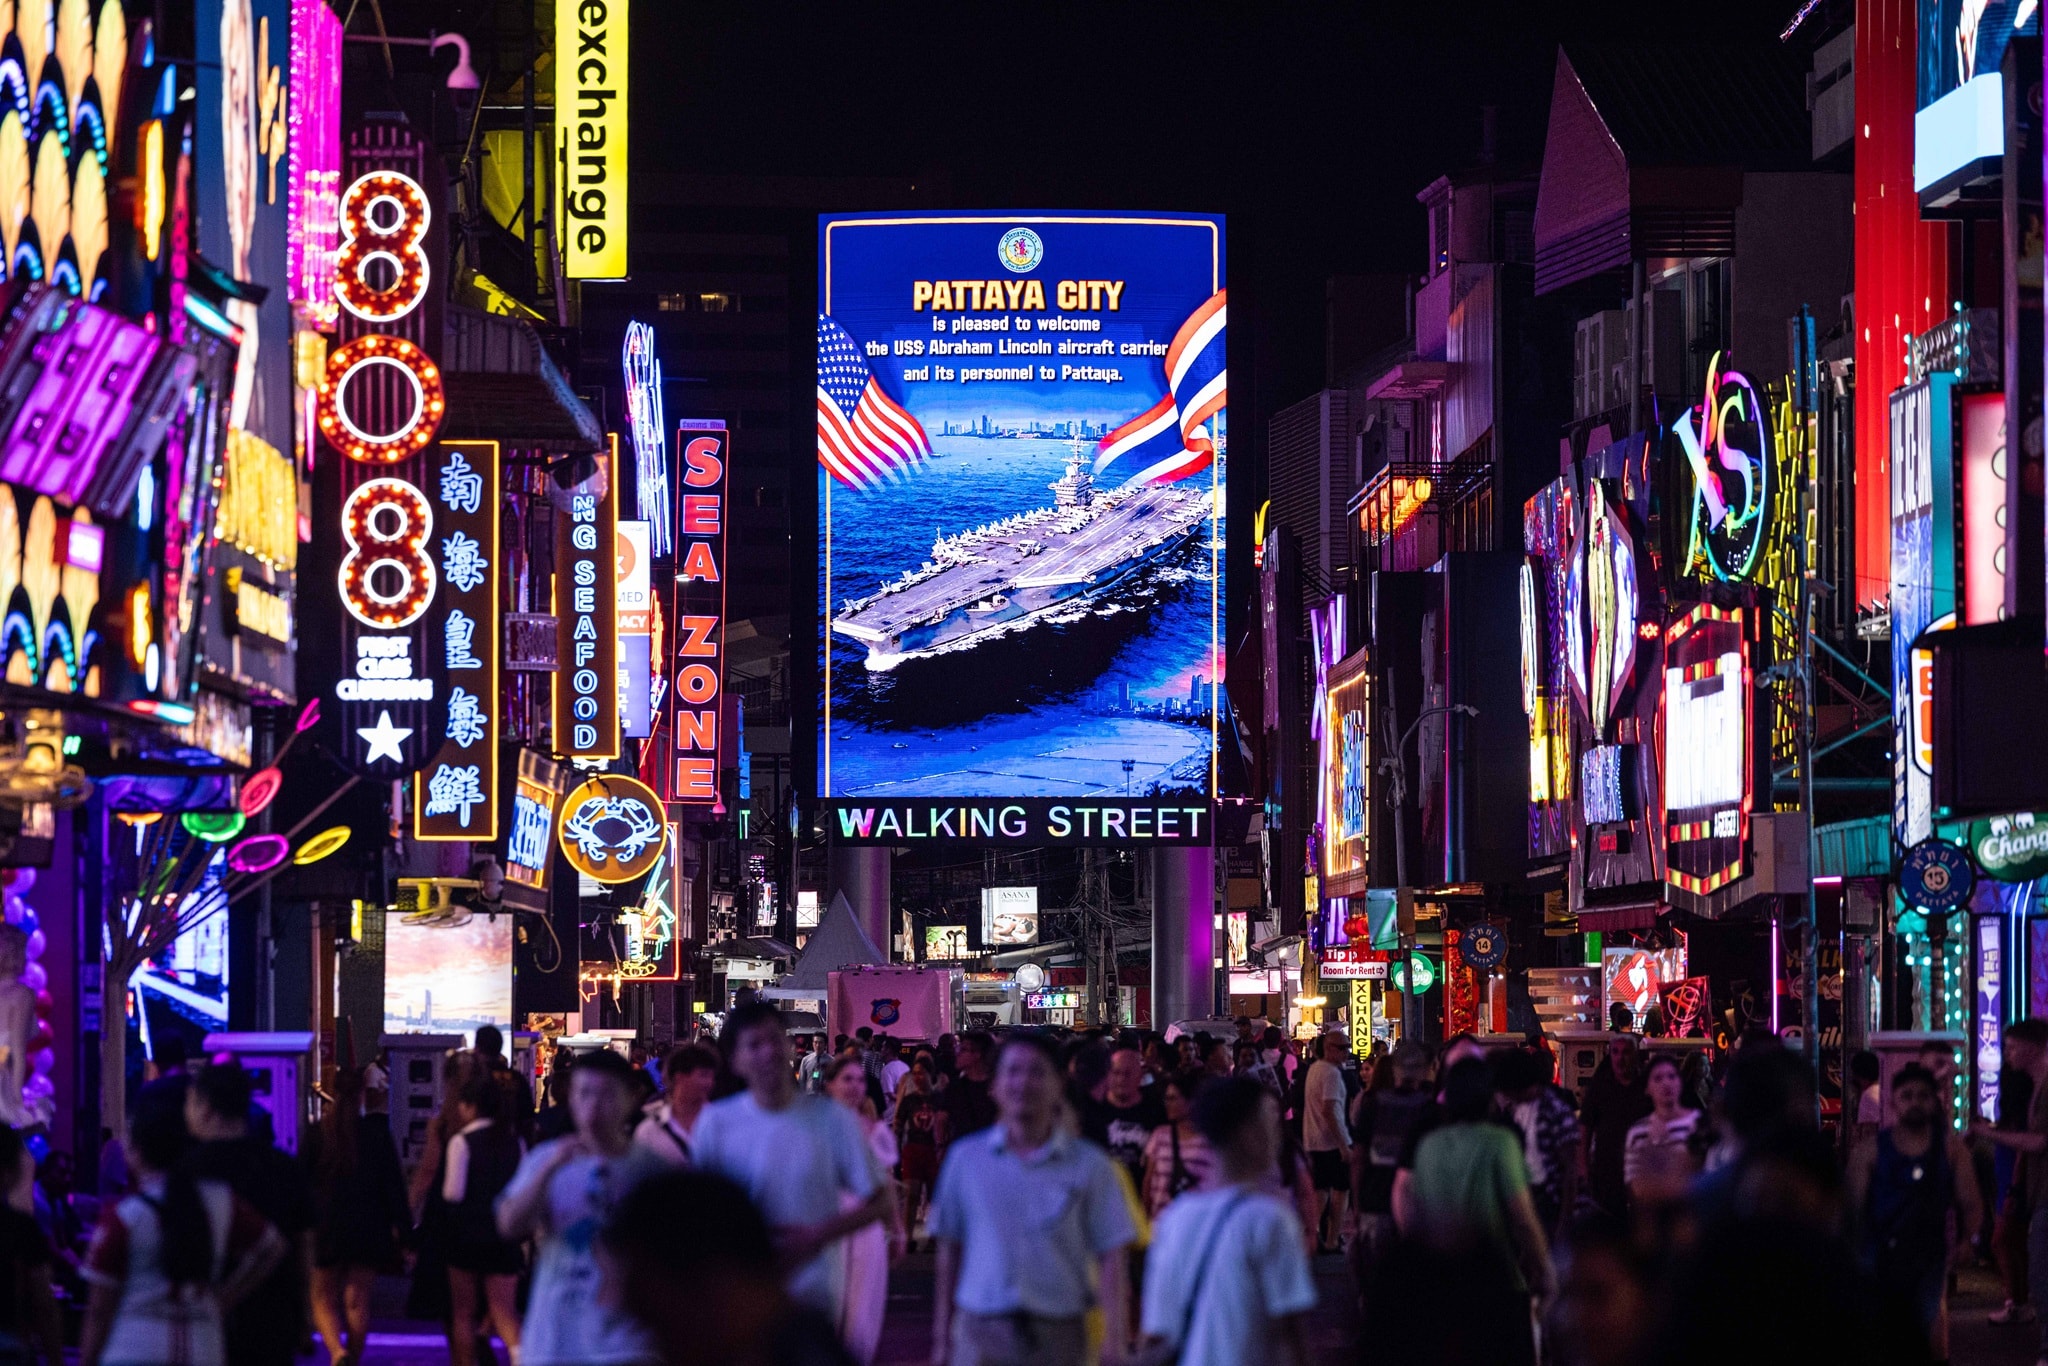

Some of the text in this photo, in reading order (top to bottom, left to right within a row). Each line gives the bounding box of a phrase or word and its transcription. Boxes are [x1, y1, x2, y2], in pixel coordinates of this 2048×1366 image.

[567, 0, 617, 254] exchange
[912, 280, 1125, 311] PATTAYA CITY
[932, 315, 1101, 335] is pleased to welcome
[865, 340, 889, 356] the
[928, 338, 993, 355] Abraham
[998, 338, 1052, 354] Lincoln
[1058, 338, 1115, 355] aircraft
[1120, 339, 1169, 356] carrier
[903, 364, 1124, 384] and its personnel to Pattaya.
[682, 436, 724, 582] SEA
[572, 559, 599, 749] SEAFOOD
[676, 615, 719, 798] ZONE
[837, 805, 1207, 838] WALKING STREET
[1983, 831, 2048, 862] Chang
[1000, 891, 1030, 899] ASANA
[1326, 949, 1344, 962] Tip
[1477, 940, 1489, 951] 14
[1323, 966, 1376, 976] Room For Rent
[1470, 953, 1499, 964] PATTAYA
[1355, 983, 1368, 1062] XCHANGE
